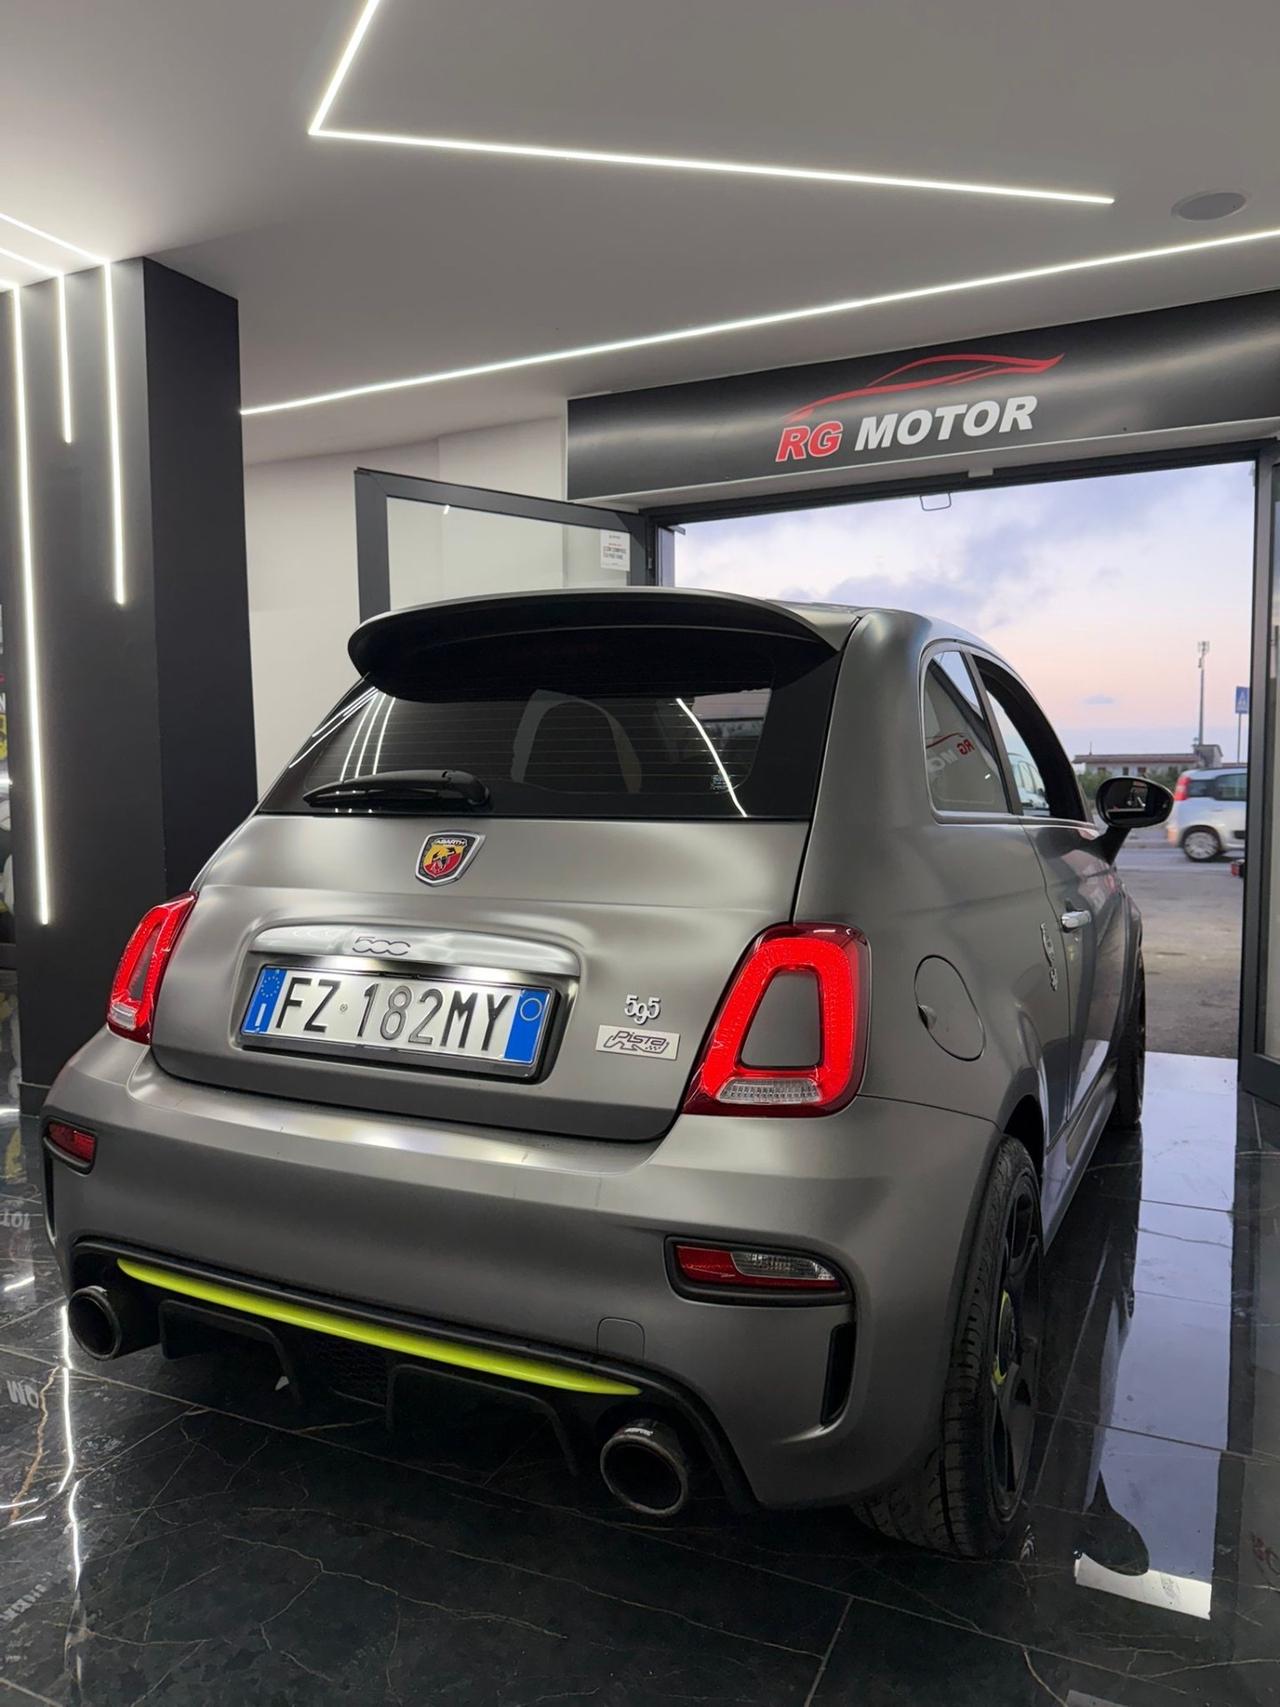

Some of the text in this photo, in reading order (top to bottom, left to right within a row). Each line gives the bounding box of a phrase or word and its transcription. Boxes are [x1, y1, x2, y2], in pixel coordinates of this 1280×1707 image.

[775, 395, 1038, 462] RG MOTOR
[624, 994, 661, 1025] 595
